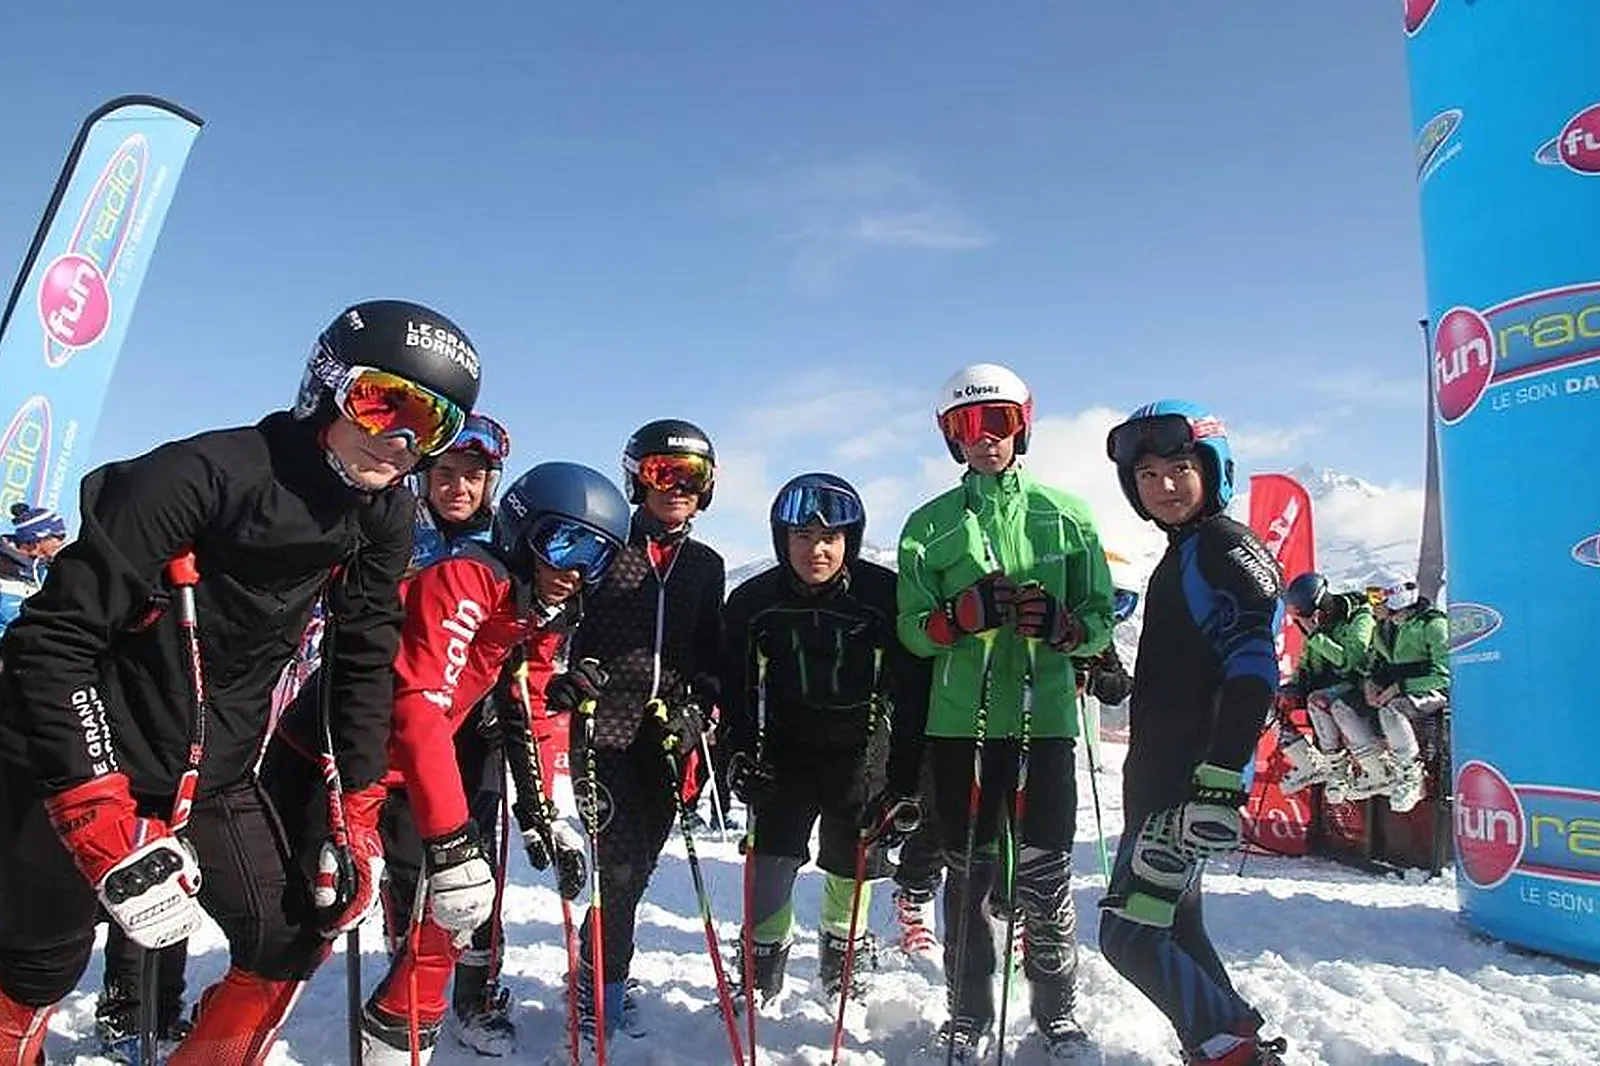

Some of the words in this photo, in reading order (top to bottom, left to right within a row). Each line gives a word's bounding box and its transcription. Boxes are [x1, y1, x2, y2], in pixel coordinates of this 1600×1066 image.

[84, 154, 138, 262] radio
[48, 263, 97, 338] fun
[408, 321, 432, 336] LE
[1436, 338, 1488, 392] fun
[1492, 392, 1511, 411] LE
[1515, 382, 1557, 404] SON
[1565, 375, 1600, 394] DA
[71, 689, 103, 758] GRAND
[93, 763, 109, 776] E
[1456, 793, 1518, 845] fun
[1520, 887, 1541, 906] LE
[1547, 890, 1595, 915] SON
